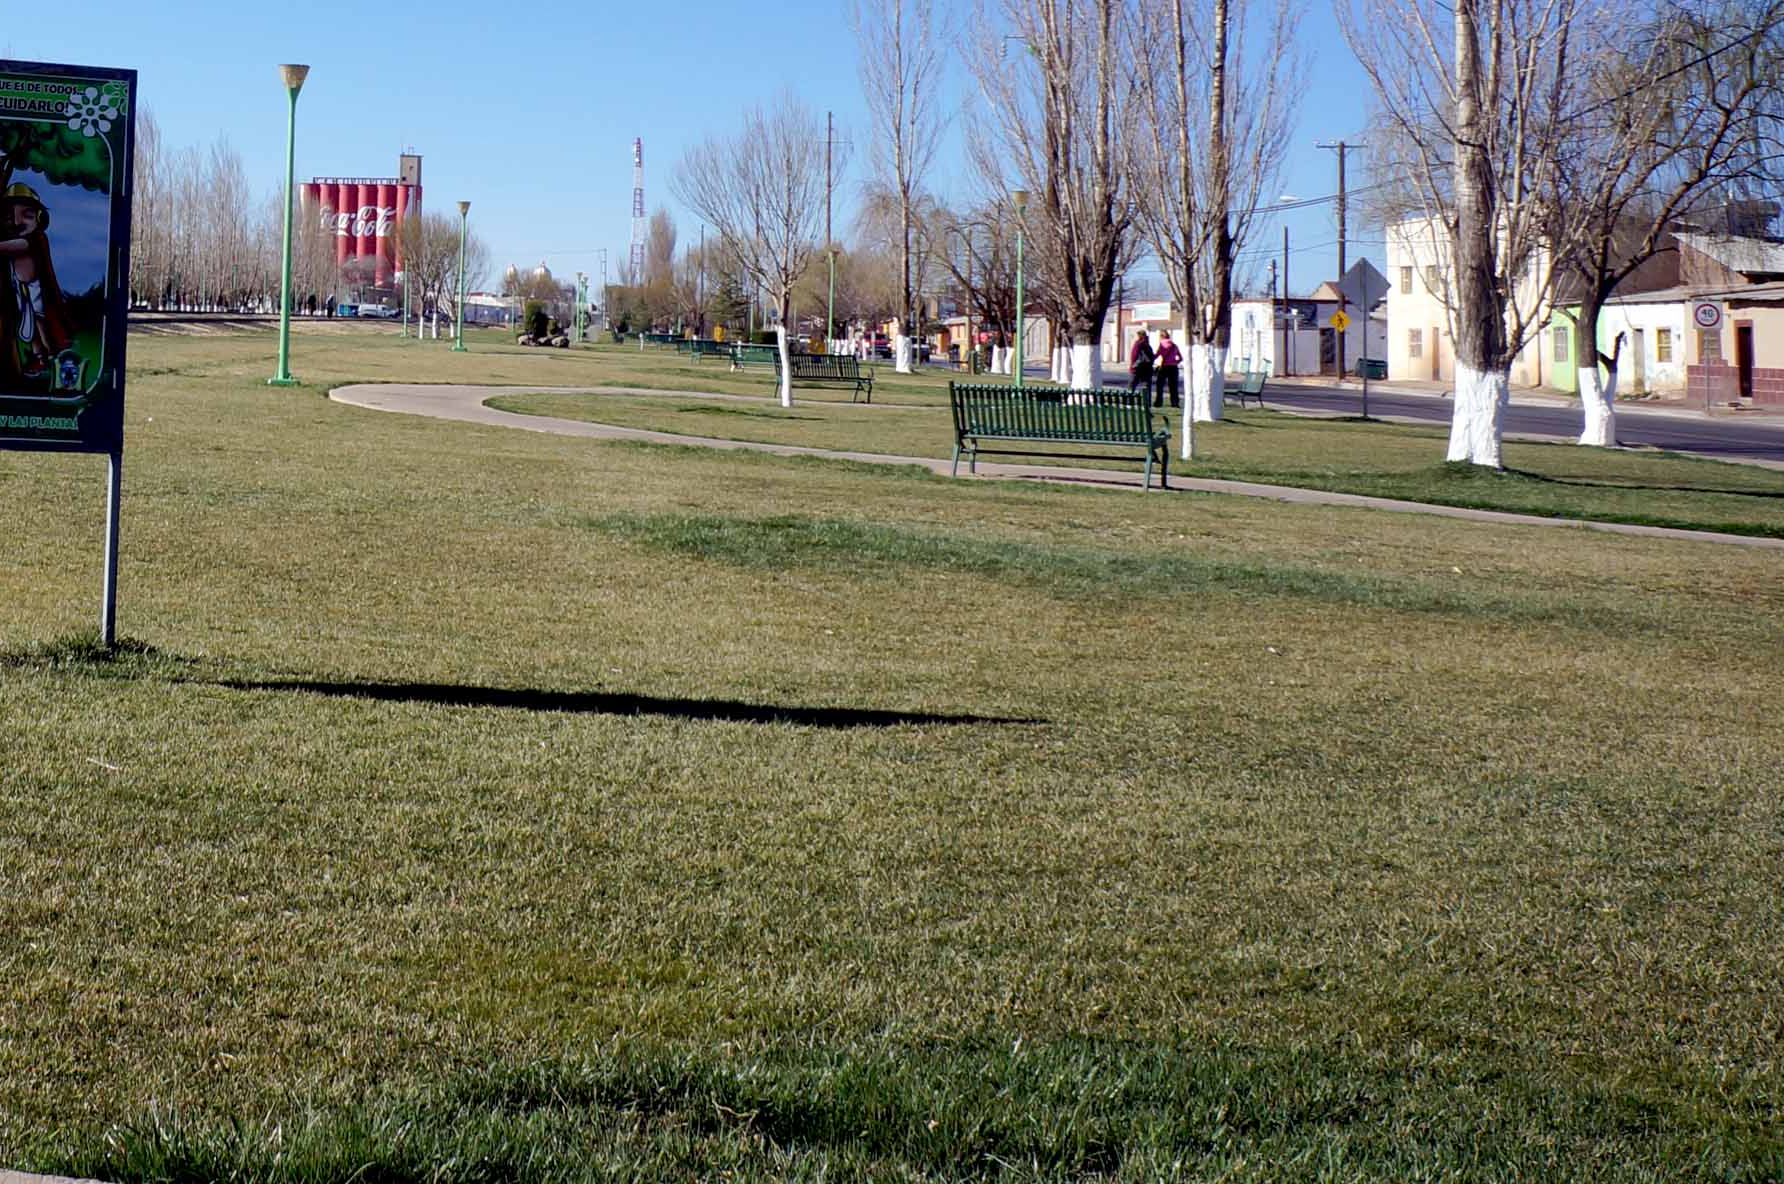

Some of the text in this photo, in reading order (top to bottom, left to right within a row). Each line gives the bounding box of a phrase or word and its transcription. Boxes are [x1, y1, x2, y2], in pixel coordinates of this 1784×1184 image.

[14, 81, 25, 91] ES
[27, 83, 41, 92] DE
[319, 205, 398, 237] Coca-Cola
[1701, 309, 1713, 318] 40
